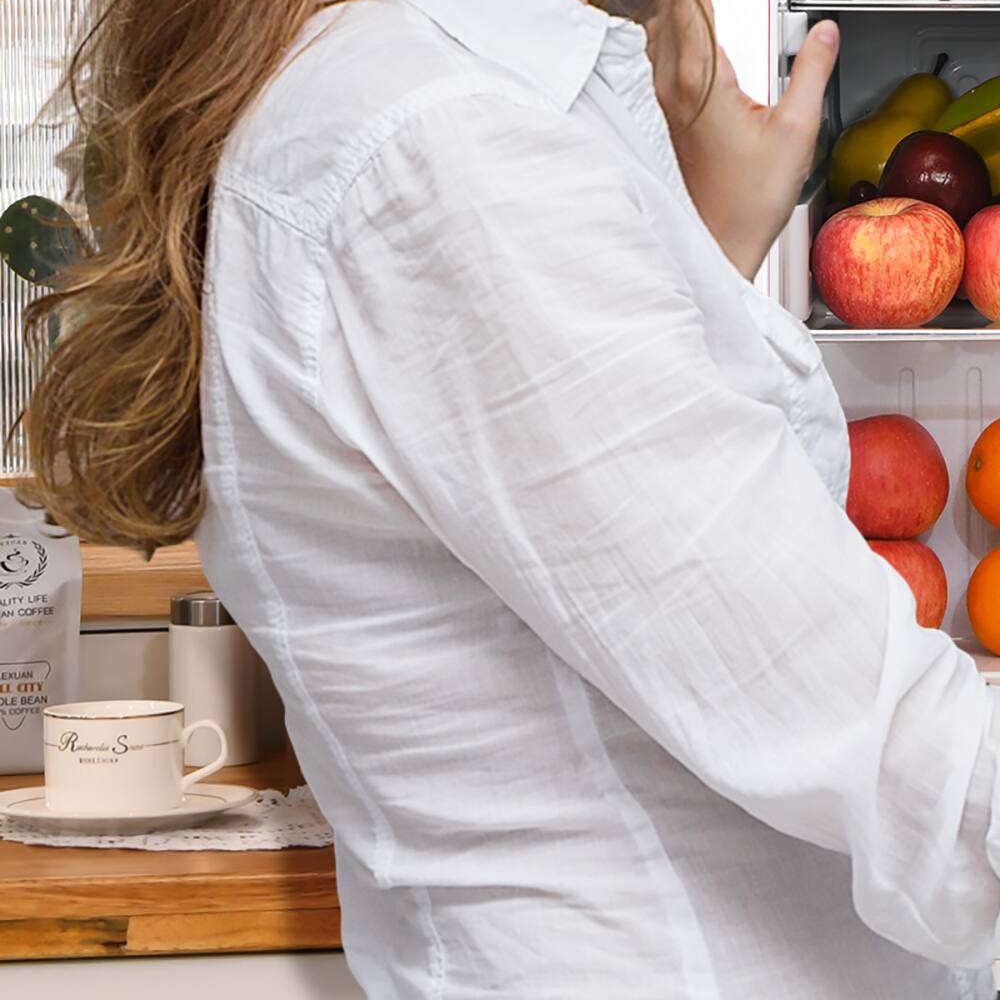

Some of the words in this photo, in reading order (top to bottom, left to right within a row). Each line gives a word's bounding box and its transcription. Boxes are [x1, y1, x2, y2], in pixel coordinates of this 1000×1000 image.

[28, 594, 48, 604] LIFE
[18, 606, 55, 617] COFFEE
[17, 681, 44, 693] CITY
[20, 695, 48, 705] BEAN
[9, 707, 41, 716] COFFEE
